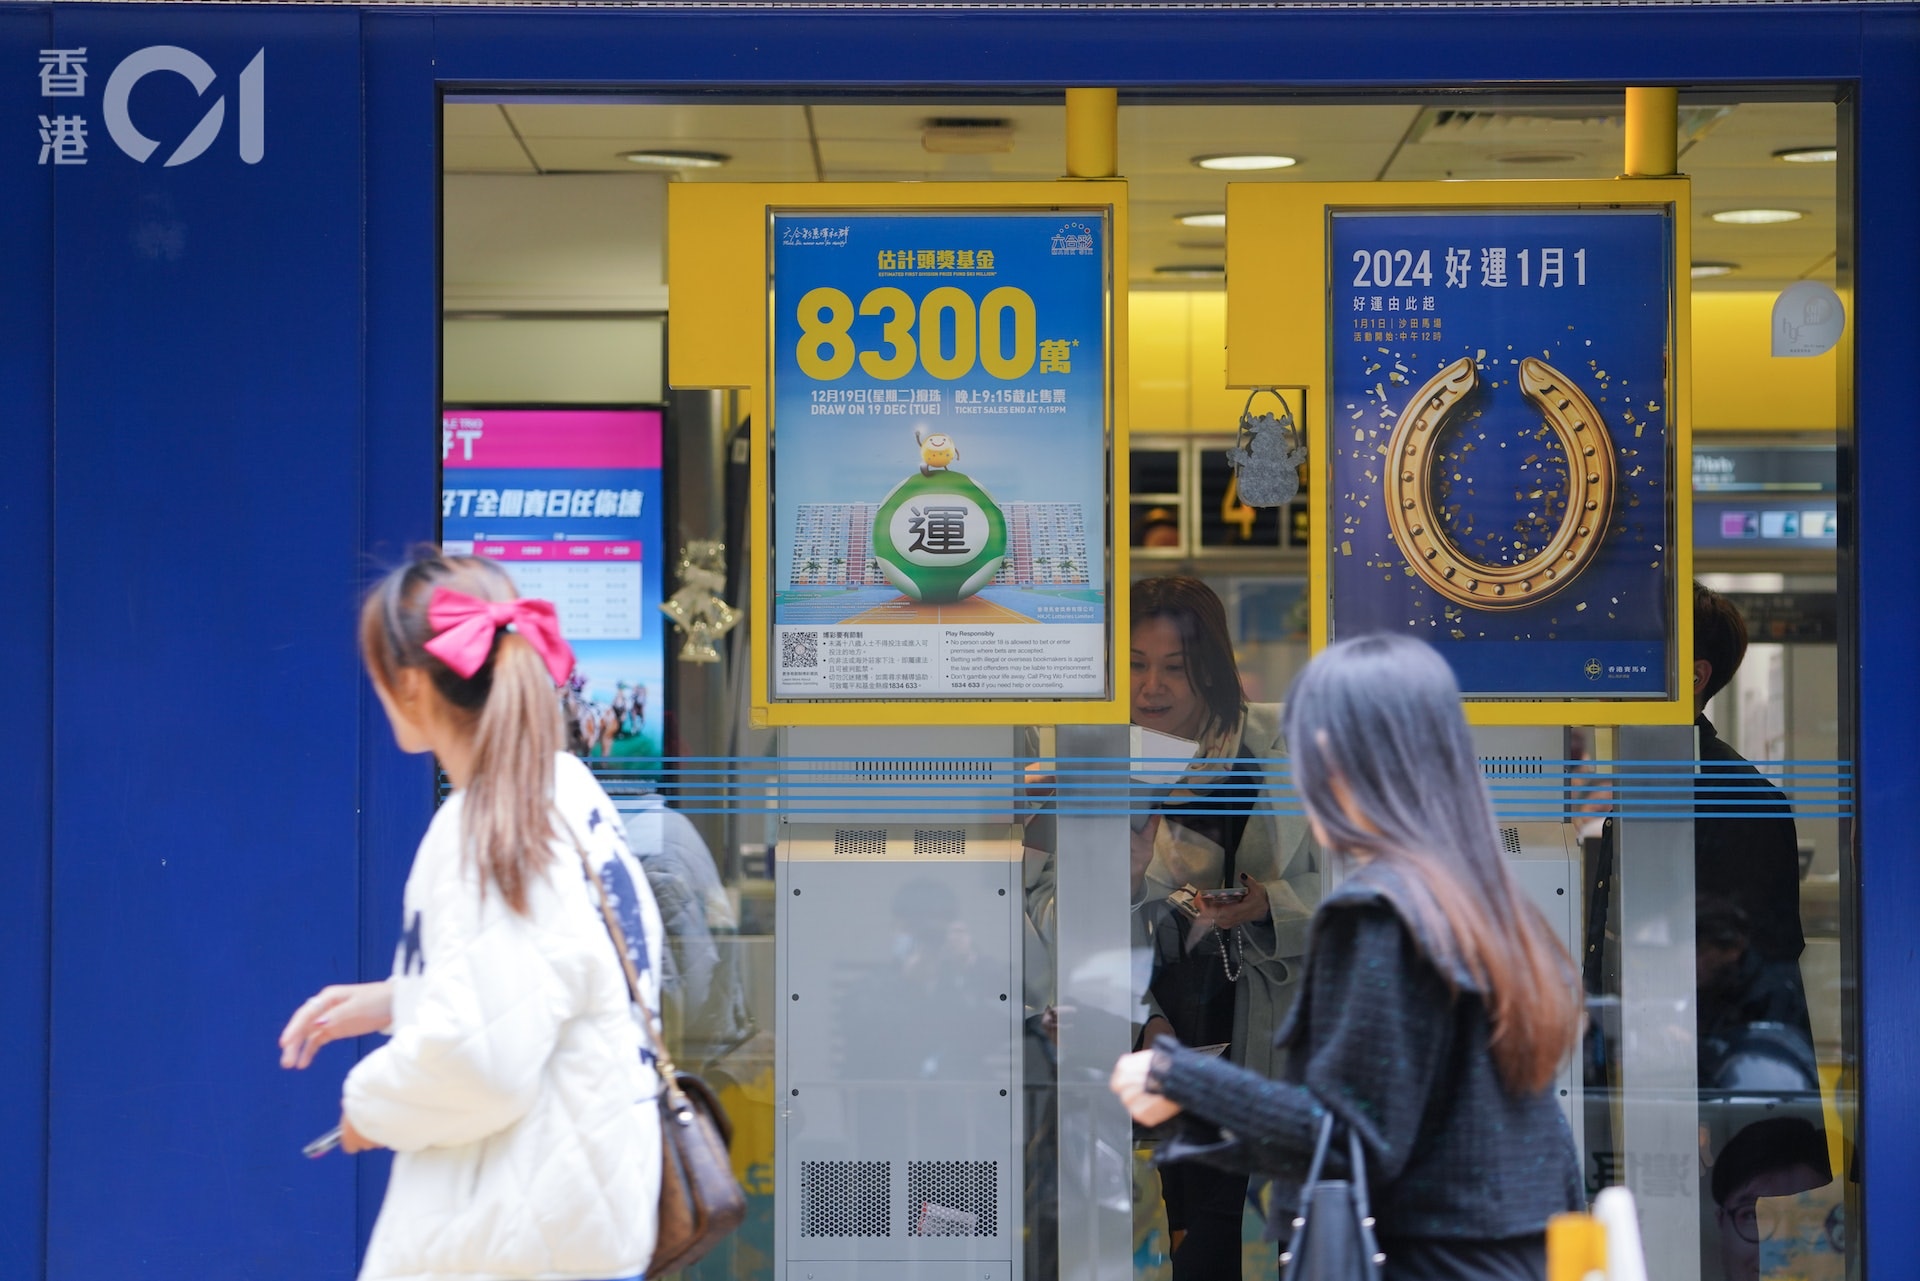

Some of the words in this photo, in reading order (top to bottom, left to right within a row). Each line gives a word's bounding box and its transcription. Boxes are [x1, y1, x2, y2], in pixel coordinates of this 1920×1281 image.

[878, 250, 995, 270] 估計頭獎基金
[1352, 249, 1433, 288] 2024
[1353, 296, 1435, 312] 好運由此起
[811, 404, 846, 415] DRAW
[848, 404, 865, 415] ON
[868, 404, 881, 415] 19
[884, 404, 907, 415] DEC
[909, 404, 940, 415] (TUE)
[955, 406, 982, 414] TICKET
[983, 406, 1008, 414] SALES
[1010, 406, 1026, 414] END
[1027, 406, 1036, 414] AT
[1038, 406, 1066, 414] 9:15PM
[460, 418, 484, 429] TRIO
[908, 506, 971, 555] 運
